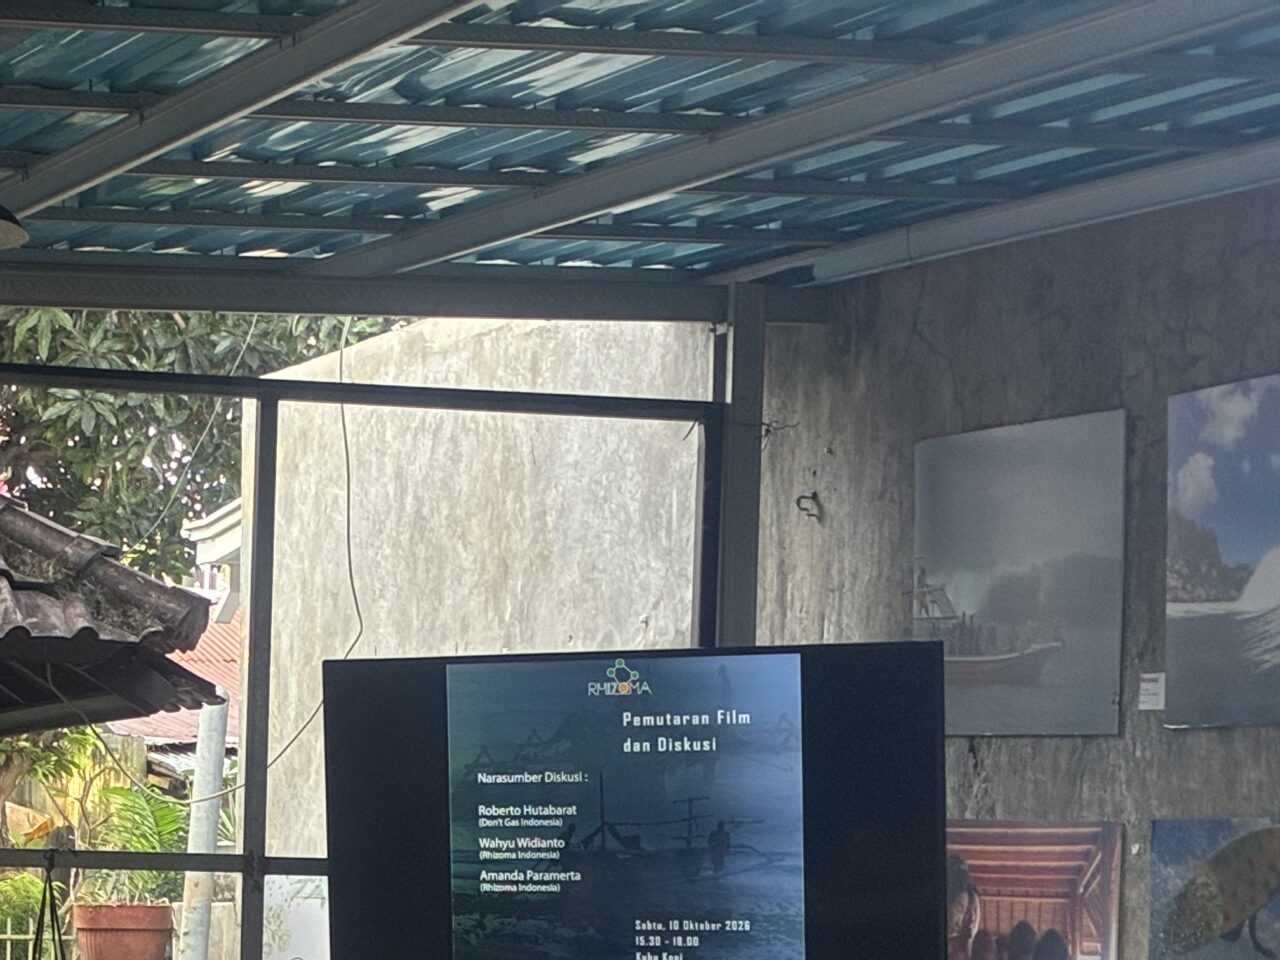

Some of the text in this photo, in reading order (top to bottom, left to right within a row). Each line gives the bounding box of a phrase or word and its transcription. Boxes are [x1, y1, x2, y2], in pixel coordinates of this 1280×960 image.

[623, 709, 751, 727] Pemutaran Film
[623, 736, 717, 752] dan Diskusi
[477, 771, 542, 784] Narasumber
[478, 804, 577, 816] Roberto Hutabarat
[504, 818, 520, 827] Gas
[521, 817, 563, 828] Indonesia)
[478, 837, 566, 851] Wahyu Widianto
[479, 850, 560, 860] (Rhizoma Indonesia)
[480, 870, 581, 881] Amanda Paramerta
[480, 883, 561, 893] (Rhizoma Indonesia)
[635, 920, 751, 932] Sabtu, 10 Oktober 2026
[635, 936, 661, 947] 15.30
[673, 936, 699, 947] 18.00
